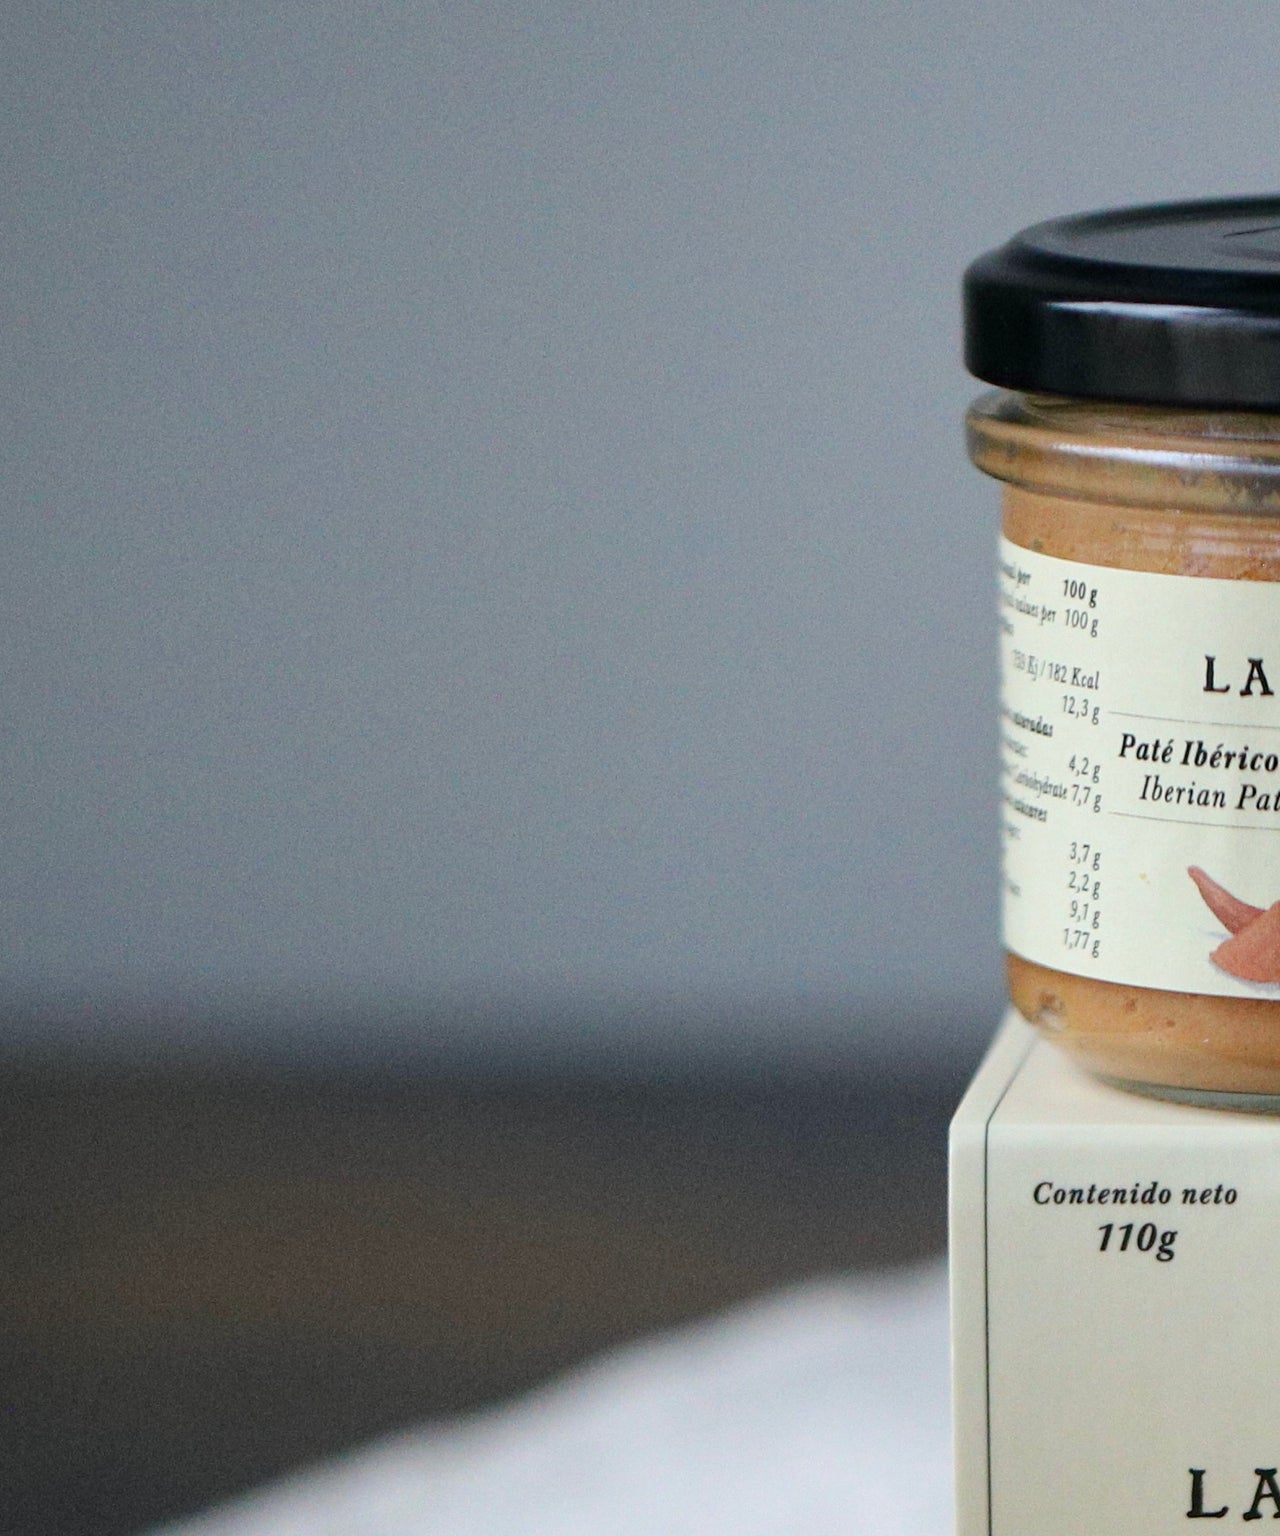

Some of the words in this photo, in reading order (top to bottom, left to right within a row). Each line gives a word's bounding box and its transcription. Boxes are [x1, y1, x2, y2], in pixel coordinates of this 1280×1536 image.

[1064, 579, 1086, 600] 100
[1089, 588, 1097, 608] g
[1065, 609, 1088, 629] 100
[1091, 618, 1098, 638] g
[1049, 662, 1067, 683] 182
[1071, 667, 1100, 690] Kcal
[1203, 655, 1274, 698] LA
[1063, 695, 1088, 718] 12,3
[1092, 706, 1099, 725] g
[1119, 732, 1174, 764] Paté
[1181, 740, 1279, 773] Ibérico
[1068, 754, 1090, 777] 4,2
[1092, 765, 1101, 784] g
[1072, 784, 1091, 806] 7,7
[1094, 795, 1101, 813] g
[1139, 774, 1227, 808] Iberian
[1070, 842, 1090, 864] 3,7
[1093, 852, 1101, 871] g
[1068, 871, 1090, 893] 2,2
[1092, 881, 1101, 900] g
[1069, 900, 1089, 923] 9,1
[1092, 911, 1100, 930] g
[1064, 928, 1090, 949] 1,77
[1092, 940, 1101, 958] g
[1033, 1181, 1172, 1205] Contenido
[1182, 1183, 1238, 1205] neto
[1098, 1222, 1178, 1262] 110g
